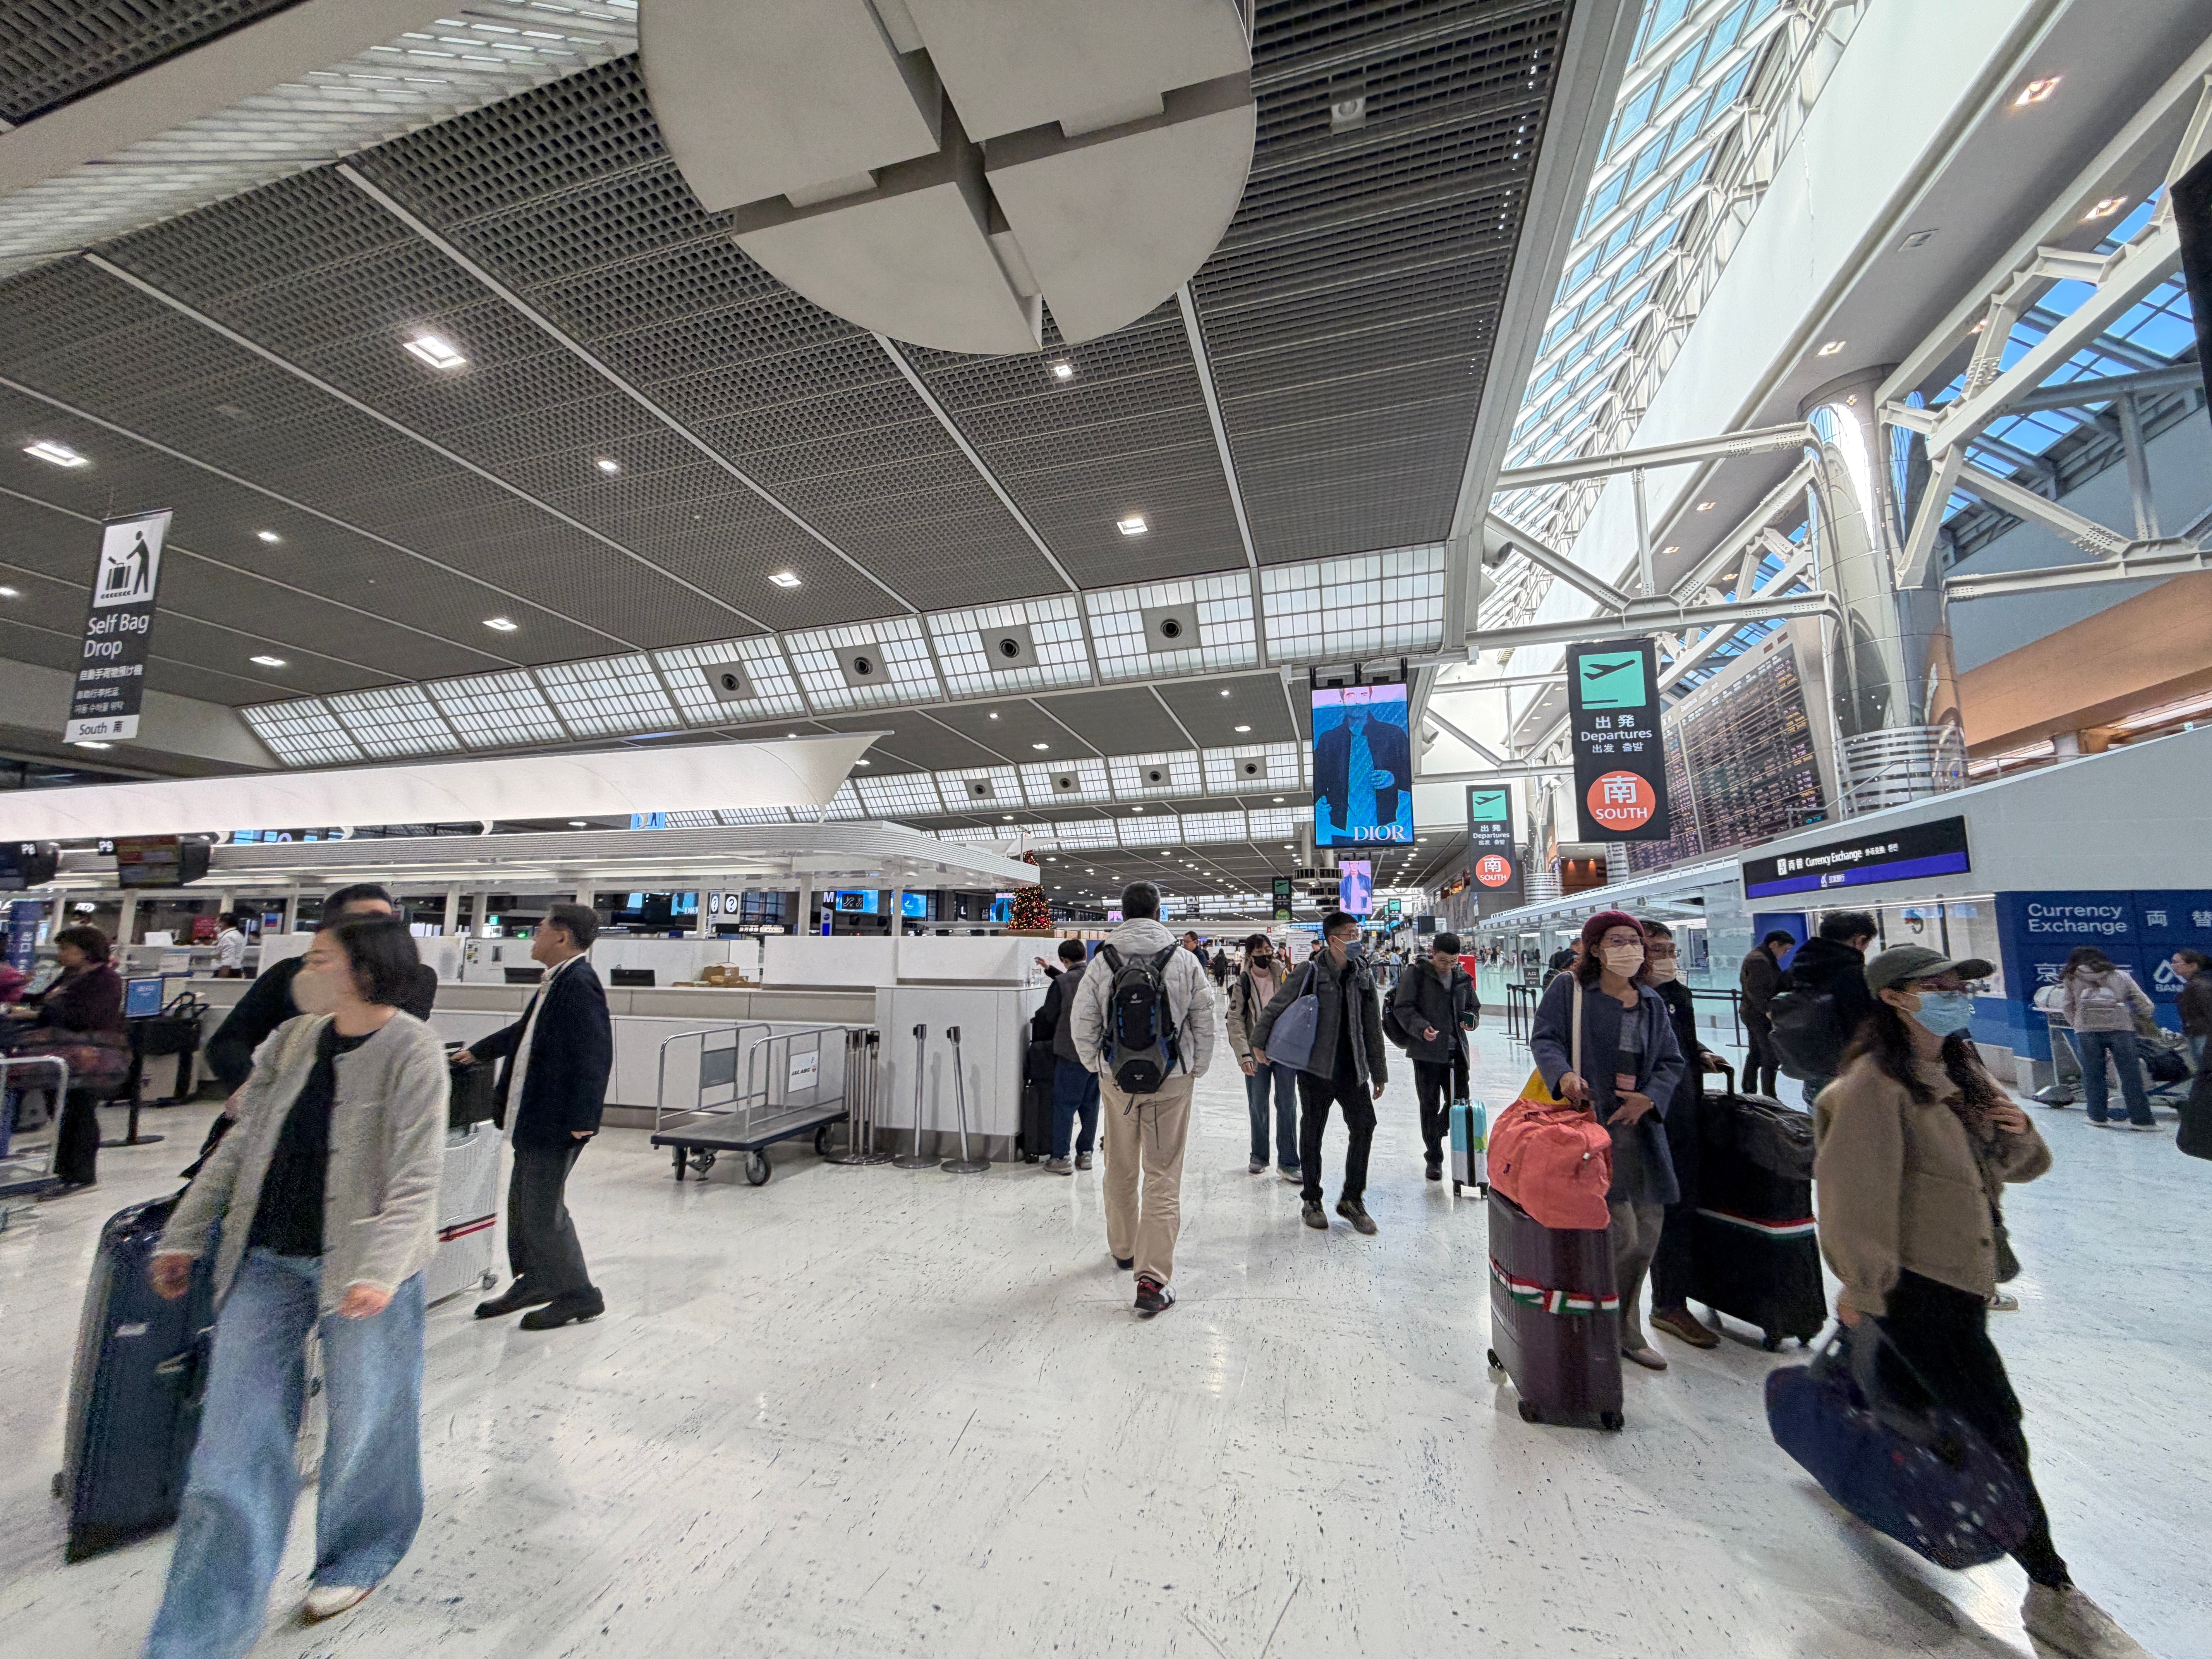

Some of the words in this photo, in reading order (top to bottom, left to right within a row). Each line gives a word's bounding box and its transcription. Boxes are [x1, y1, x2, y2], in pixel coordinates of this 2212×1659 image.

[86, 613, 118, 635] Self
[119, 614, 149, 634] Bag
[84, 640, 123, 659] Drop
[79, 722, 107, 735] South
[1595, 714, 1635, 729] 出発
[1581, 730, 1652, 743] Departures
[1592, 743, 1615, 753] 出发
[1622, 742, 1644, 752] 출발
[1601, 775, 1637, 804] 南
[1595, 807, 1648, 820] SOUTH
[1353, 825, 1407, 841] DIOR
[1483, 857, 1502, 872] 南
[1805, 856, 1831, 867] Currency
[1831, 850, 1862, 861] Exchange
[823, 891, 834, 903] M
[2028, 903, 2122, 919] Currency
[2028, 919, 2127, 935] Exchange
